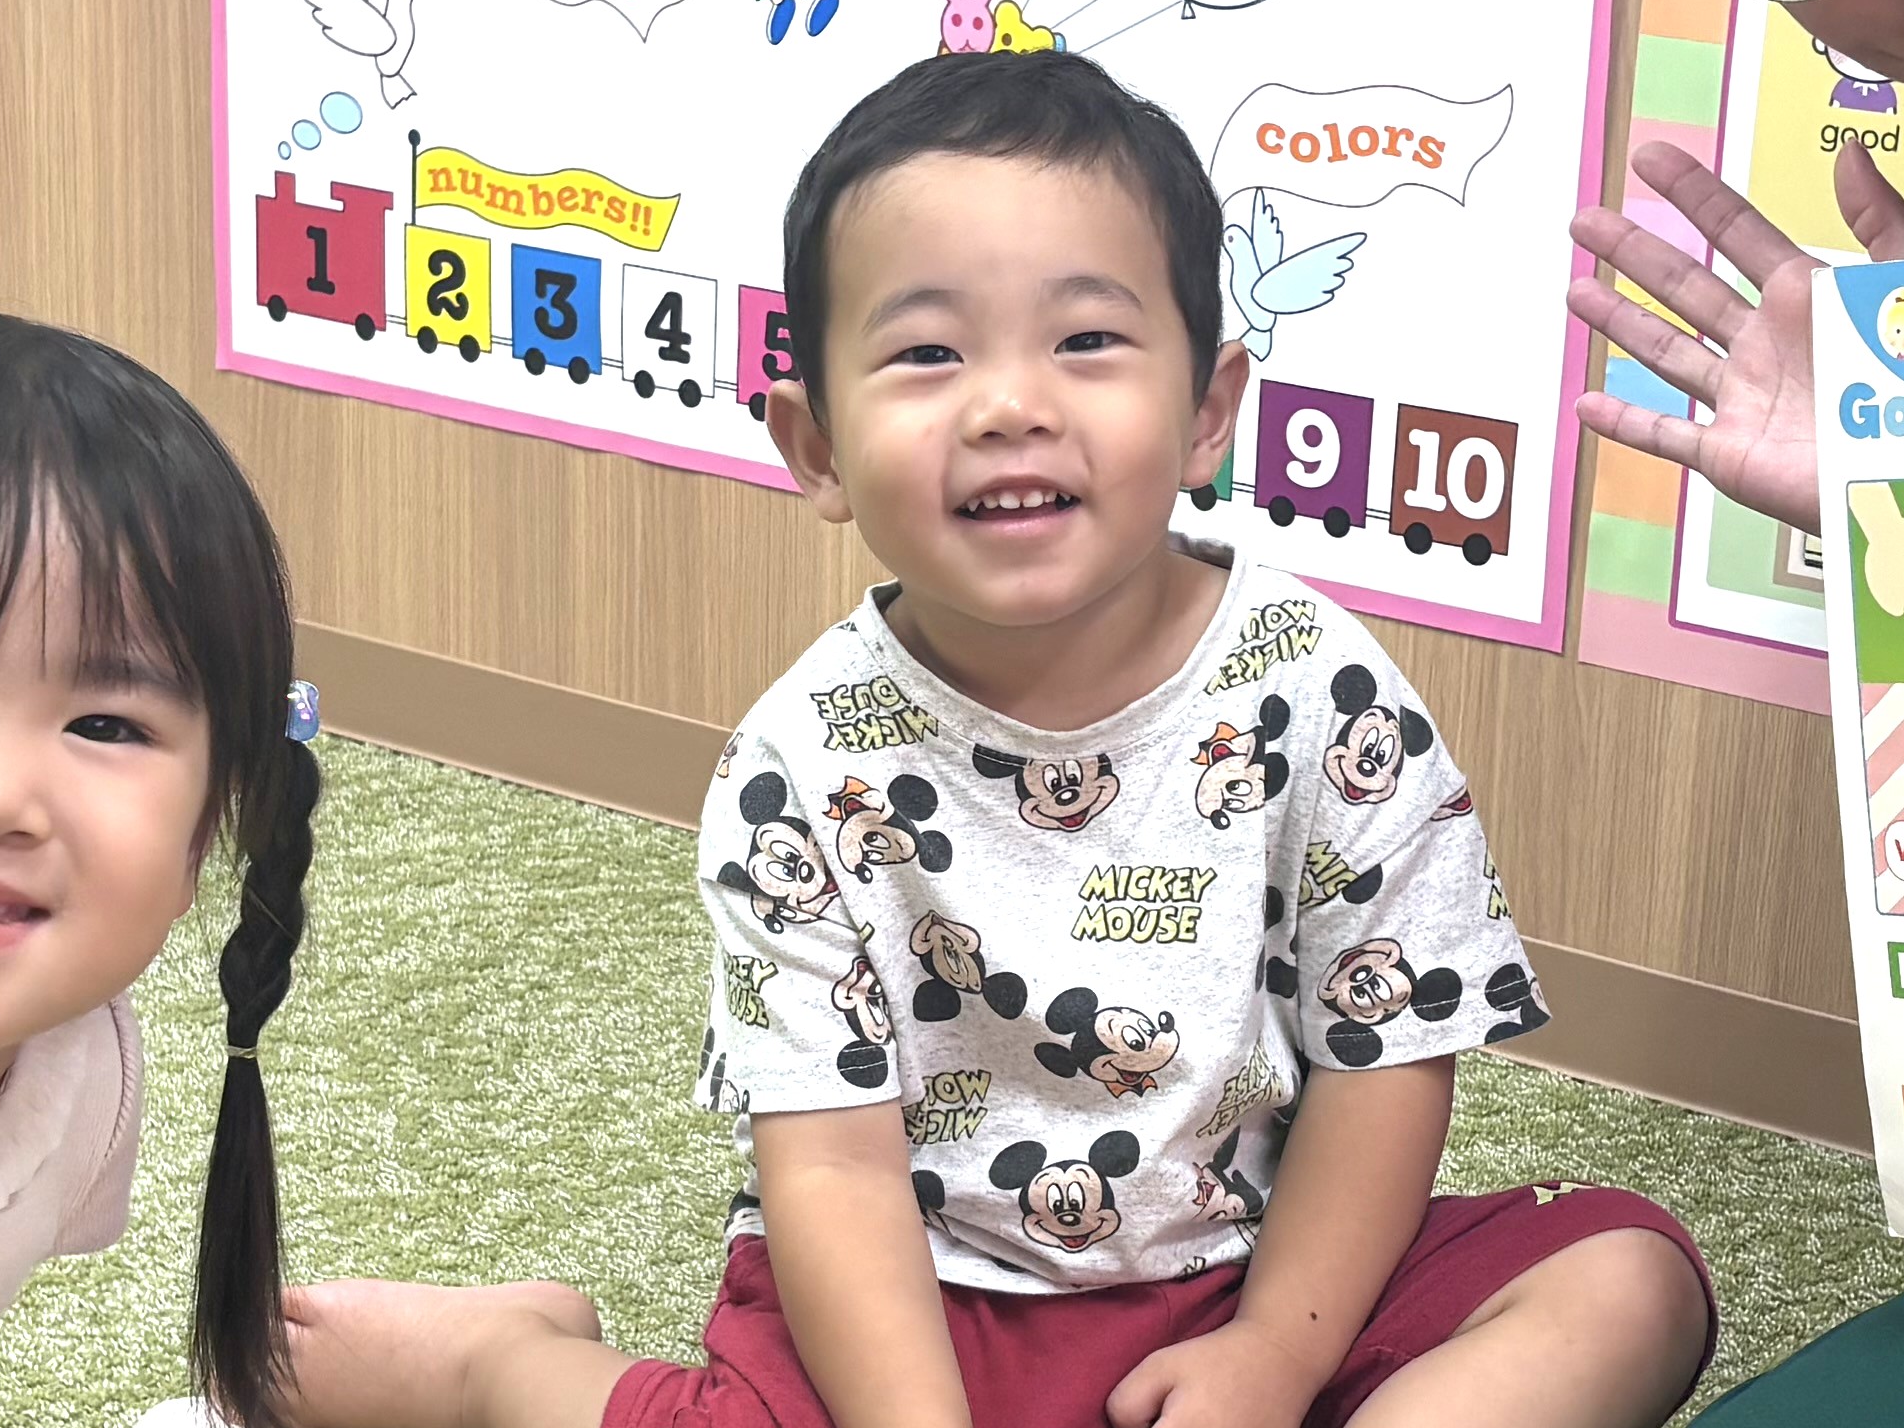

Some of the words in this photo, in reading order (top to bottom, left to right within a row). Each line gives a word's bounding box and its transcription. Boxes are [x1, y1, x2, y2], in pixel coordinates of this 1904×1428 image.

[1256, 122, 1446, 169] colors
[1820, 124, 1900, 152] good
[427, 165, 653, 236] numbers!!
[306, 227, 336, 295] 1
[427, 250, 470, 321] 2
[534, 268, 578, 341] 3
[644, 291, 693, 364] 4
[1285, 408, 1341, 489] 9
[1404, 428, 1507, 520] 10
[1239, 599, 1316, 643] MOU
[809, 675, 911, 721] OUSE
[823, 705, 939, 753] MICKEY
[1078, 864, 1217, 903] MICKEY
[1071, 903, 1202, 943] MOUSE
